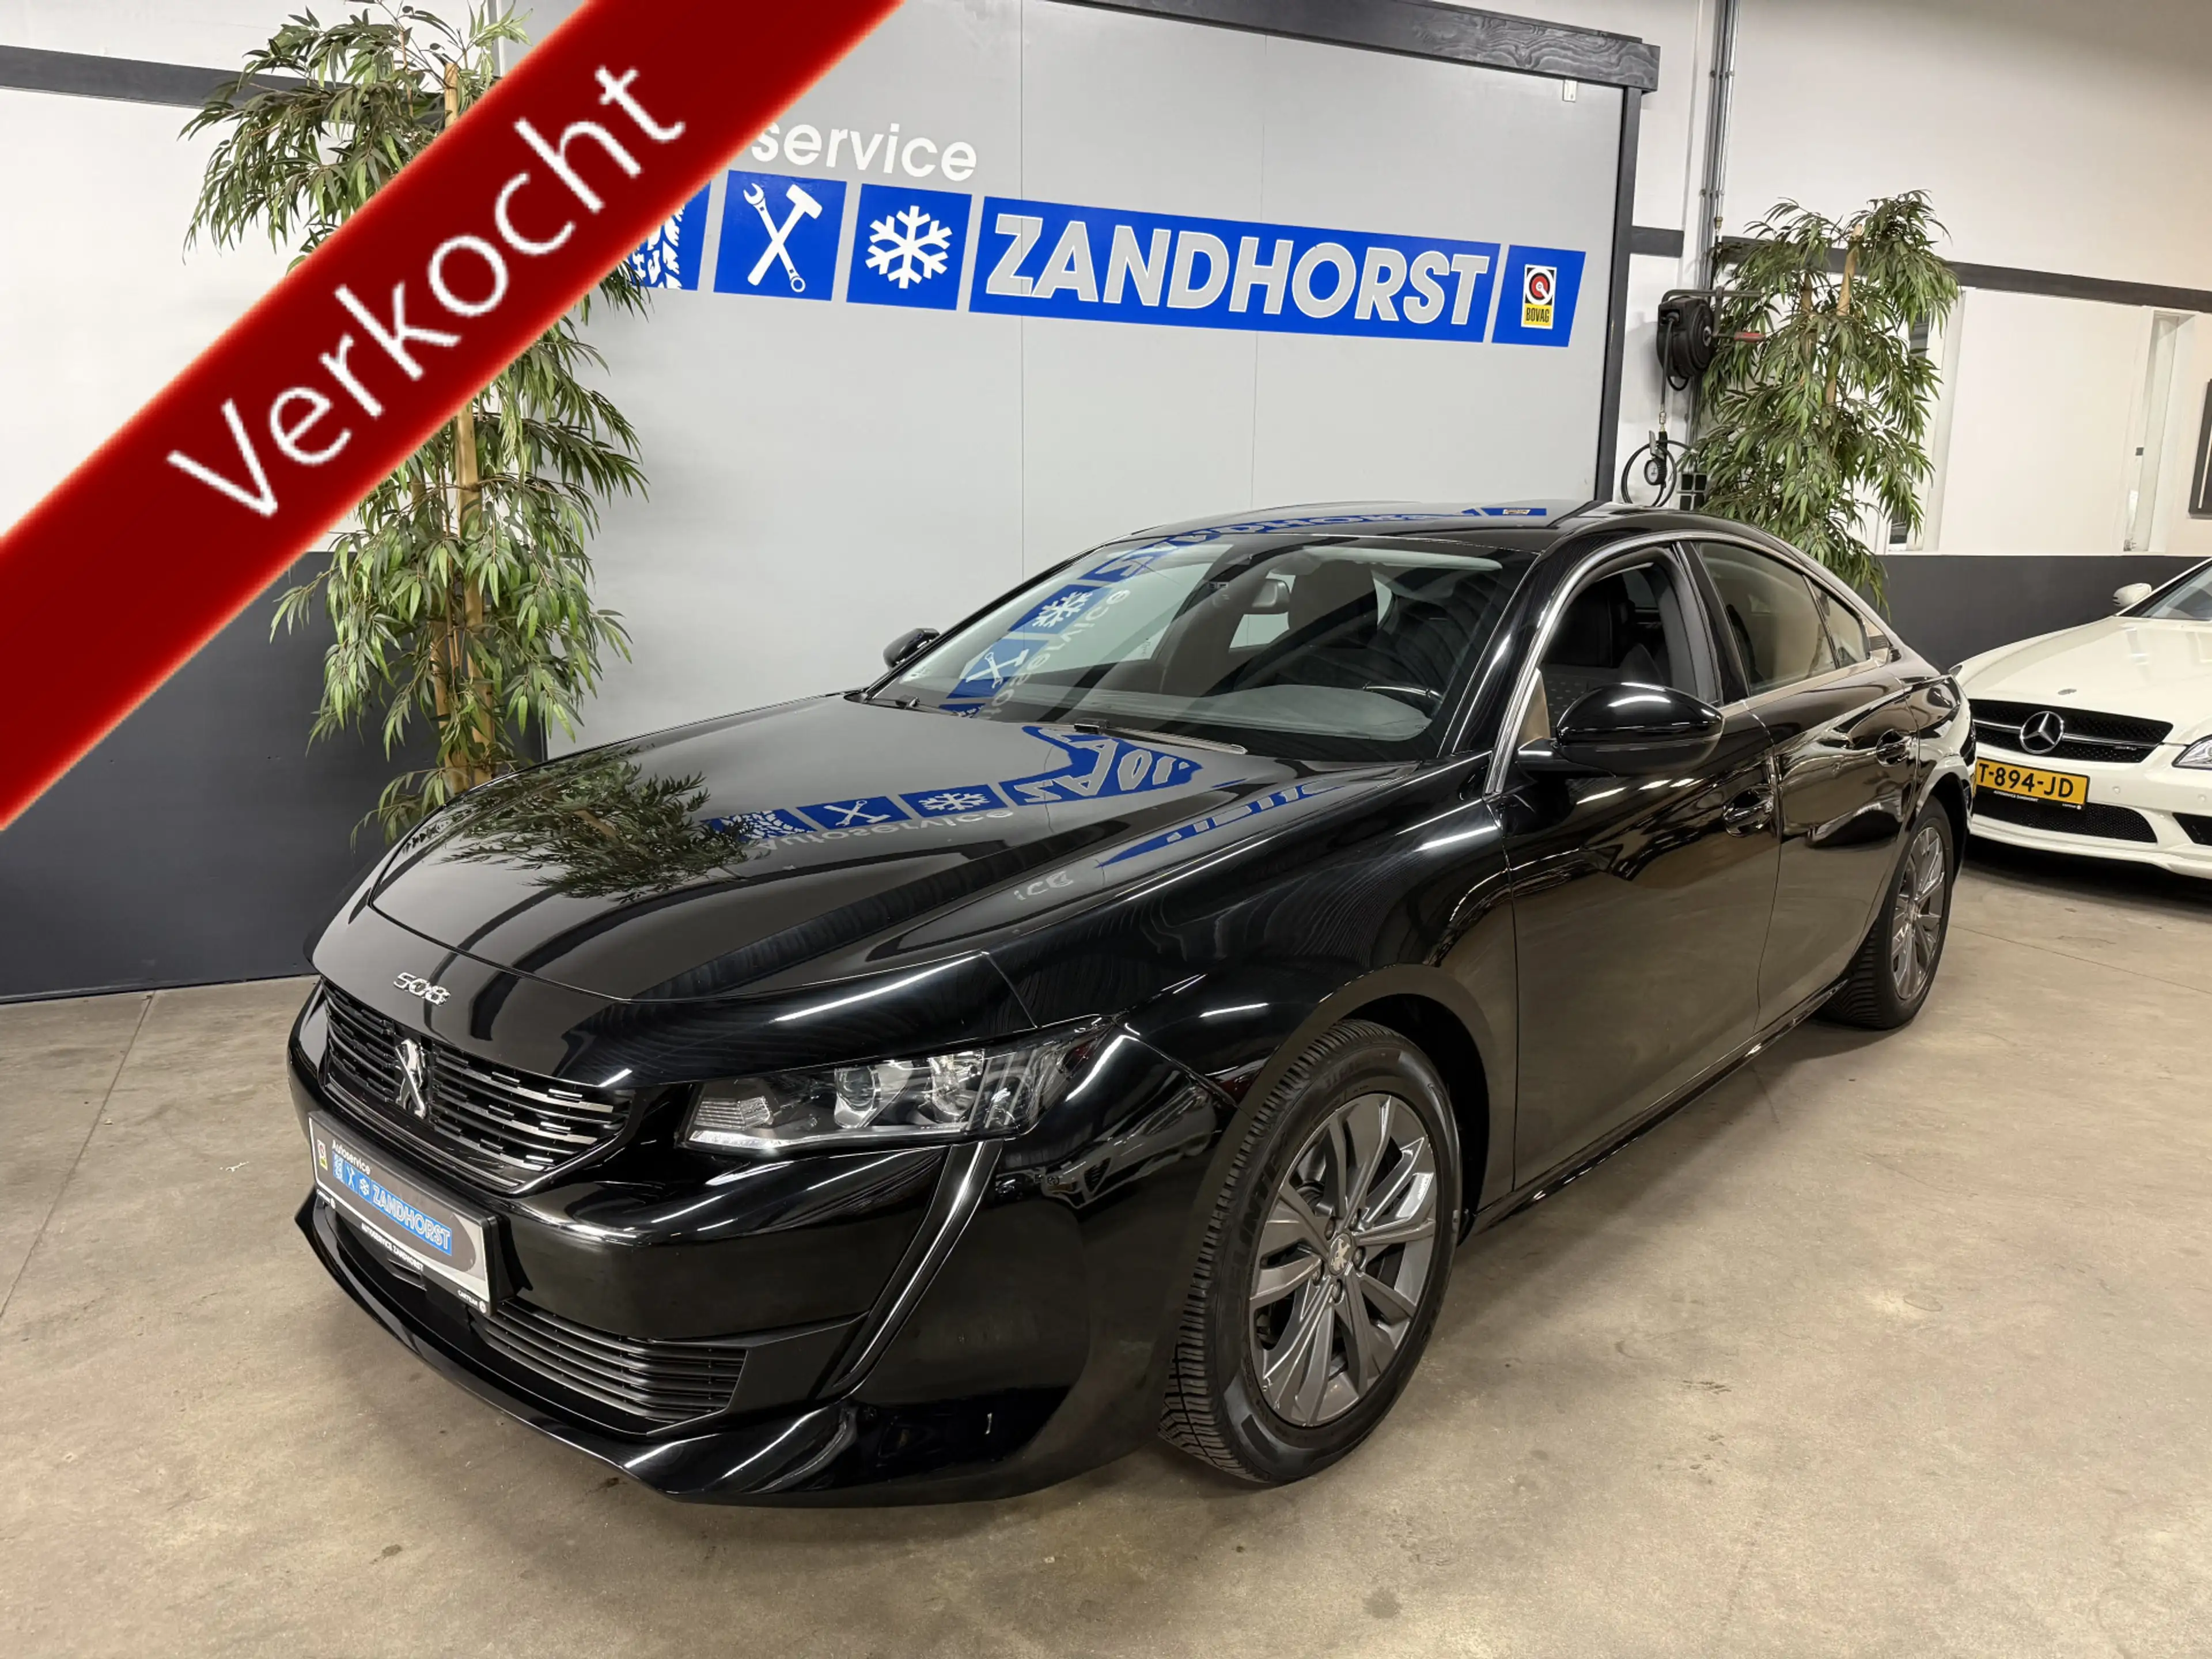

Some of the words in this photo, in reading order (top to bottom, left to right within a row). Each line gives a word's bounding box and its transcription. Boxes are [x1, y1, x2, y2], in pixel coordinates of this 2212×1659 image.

[985, 213, 1490, 325] ZANDHORST
[1526, 307, 1550, 323] BOVAG
[1978, 763, 2074, 798] T-894-JD
[393, 972, 451, 1005] 508
[332, 1139, 371, 1175] Autoservice
[373, 1184, 450, 1249] ZANDHORST
